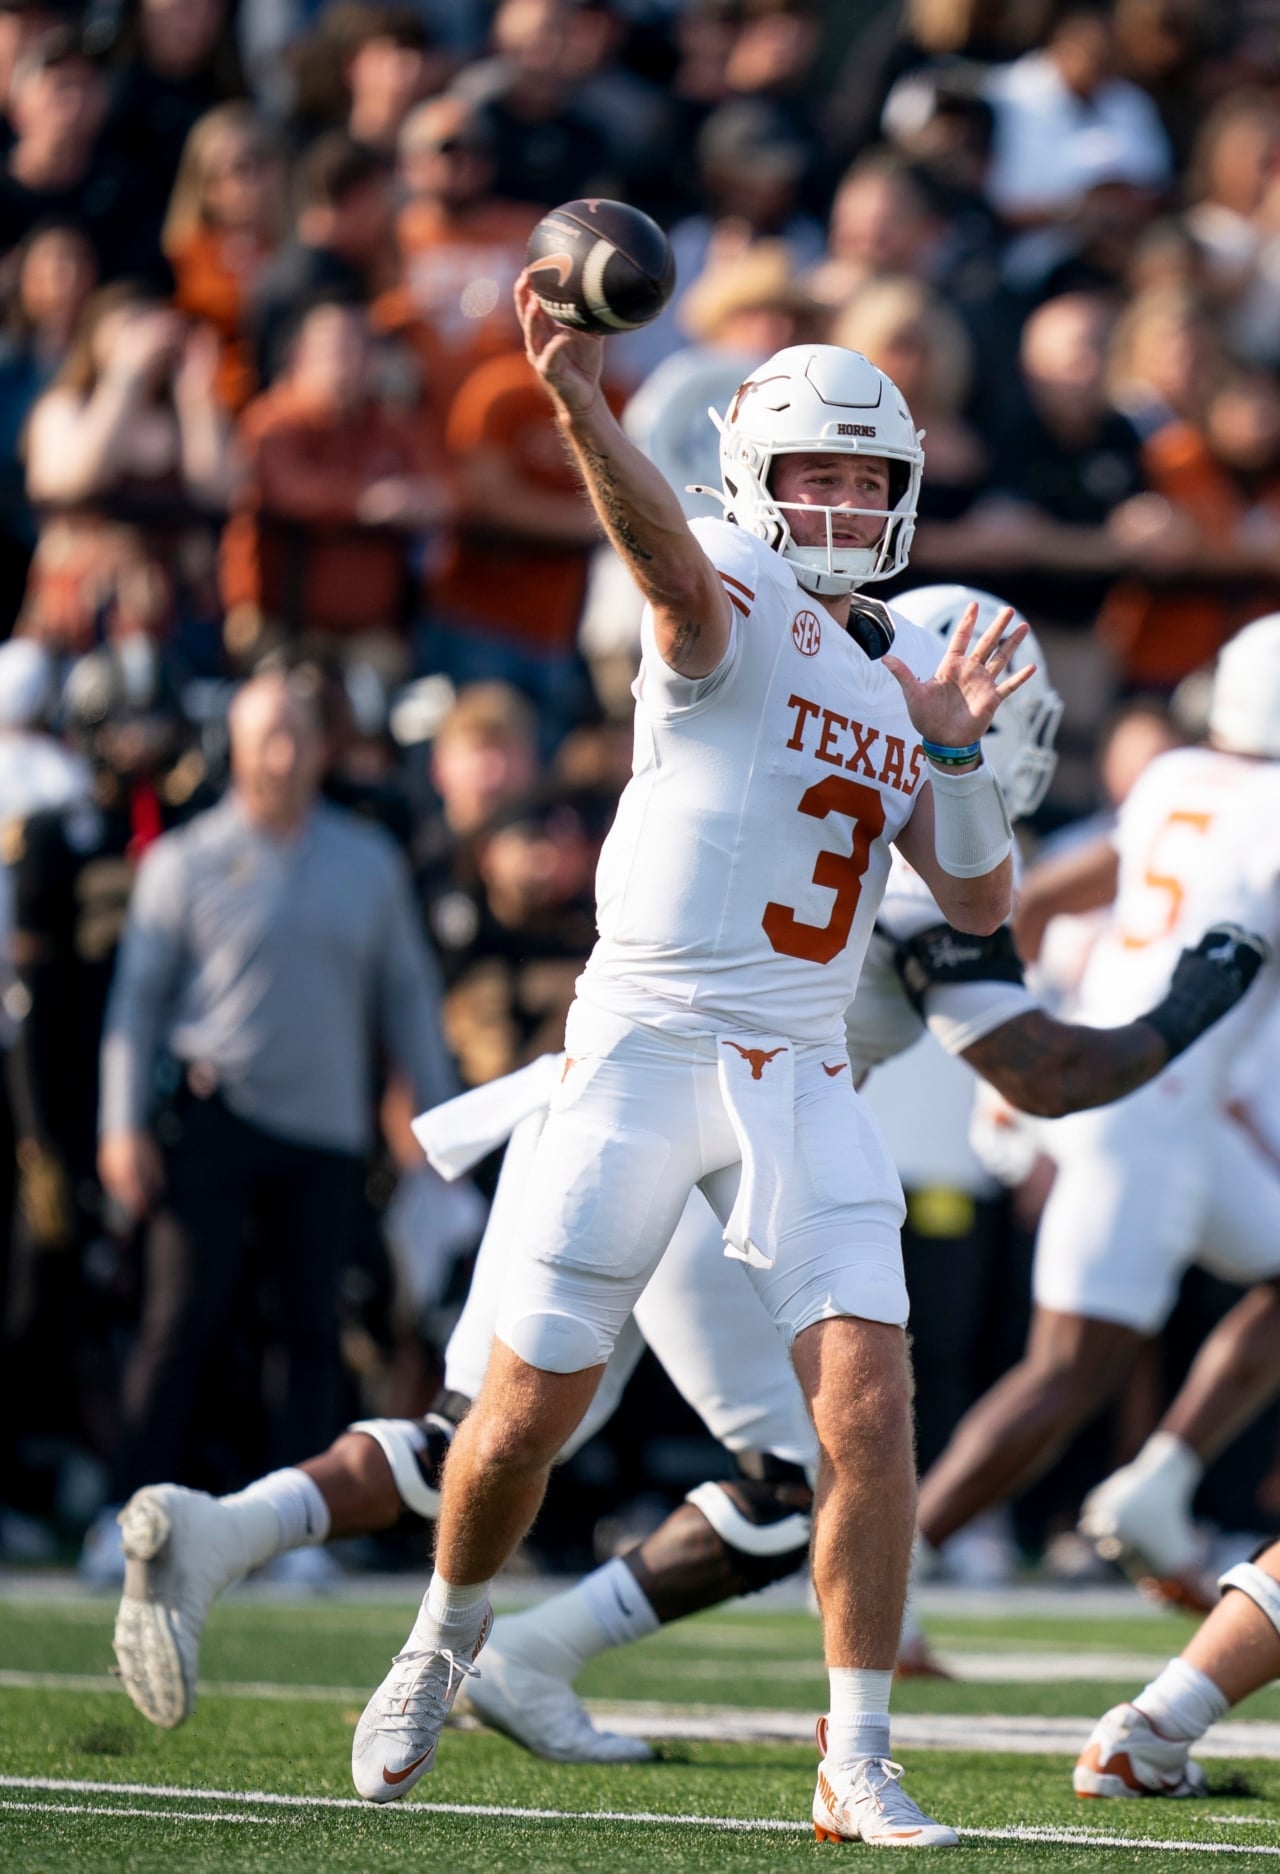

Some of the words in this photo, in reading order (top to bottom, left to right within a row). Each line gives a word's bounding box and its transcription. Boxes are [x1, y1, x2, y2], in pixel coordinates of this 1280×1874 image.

[837, 423, 877, 437] HORNS
[792, 610, 821, 656] SEC
[786, 693, 927, 797] TEXAS
[761, 774, 886, 965] 3
[1121, 811, 1213, 950] 5
[818, 1770, 840, 1816] NIKE
